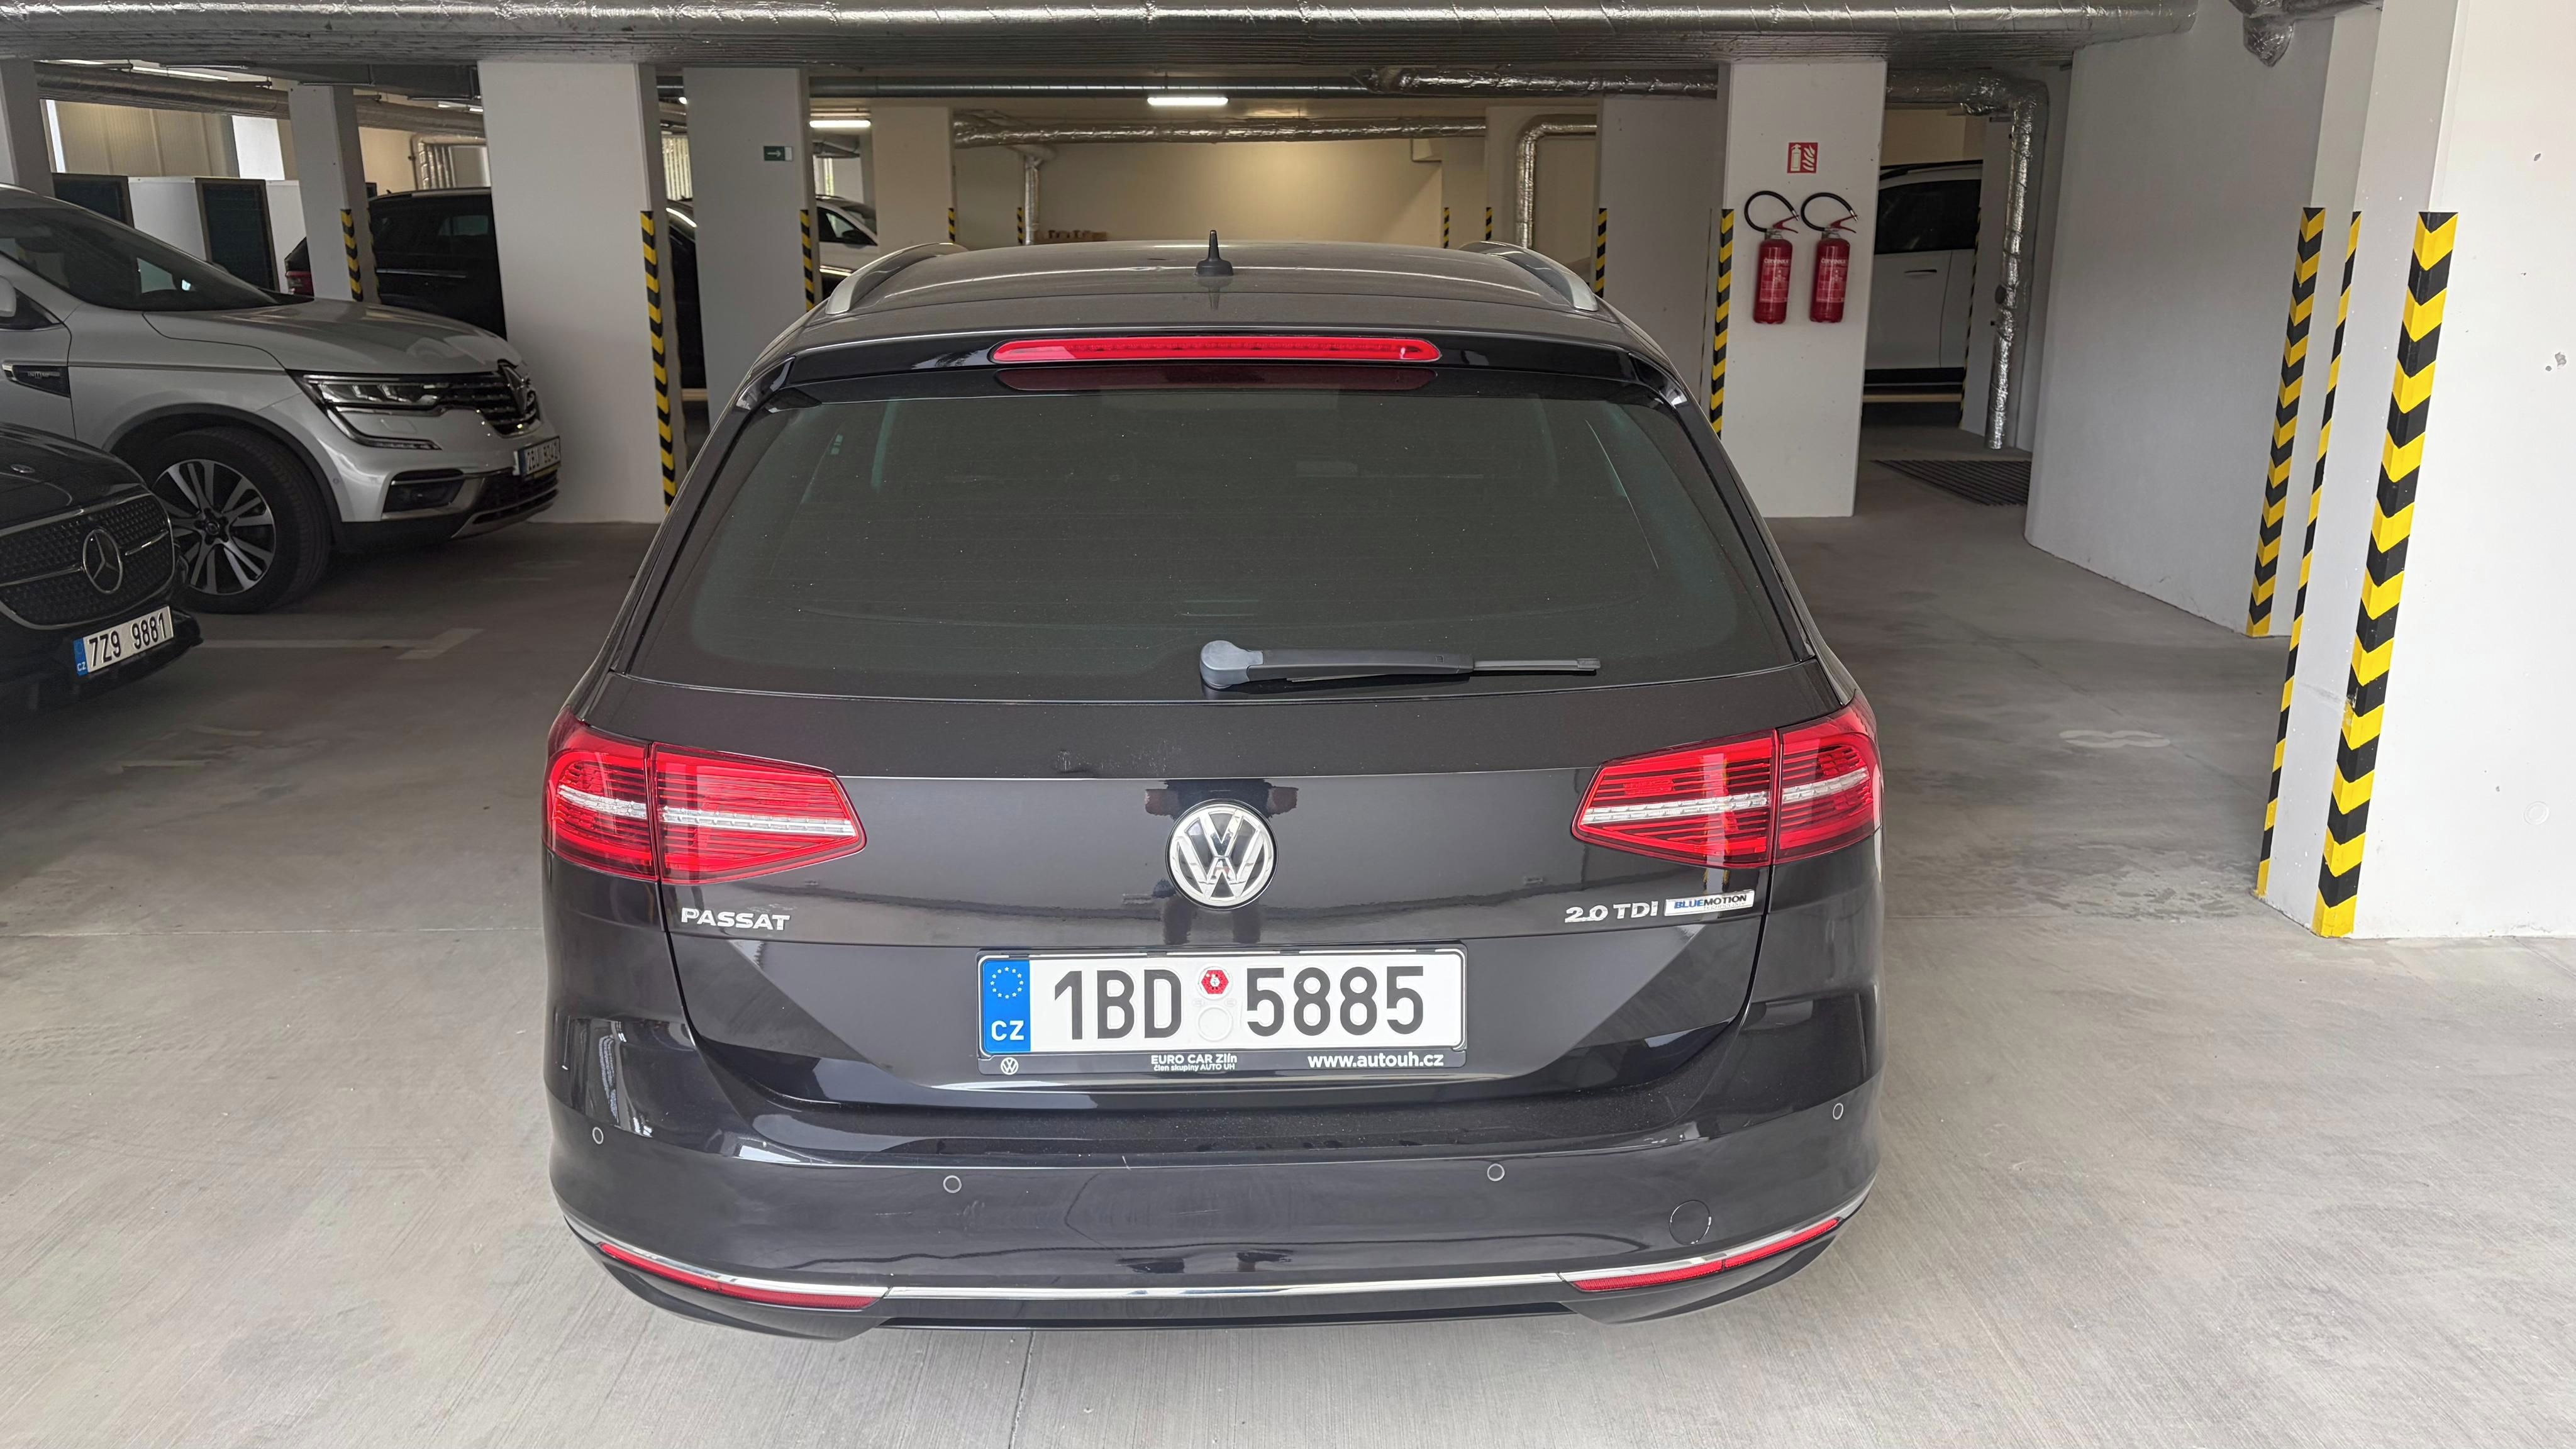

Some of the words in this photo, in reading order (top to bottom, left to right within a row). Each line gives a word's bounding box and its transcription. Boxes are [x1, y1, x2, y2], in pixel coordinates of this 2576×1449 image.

[89, 630, 121, 667] 7Z9
[131, 612, 167, 650] 9881
[77, 661, 87, 672] CZ
[1674, 894, 1747, 909] BLUEMOTION
[680, 907, 791, 931] PASSAT
[1564, 904, 1609, 923] 2.0
[1613, 901, 1659, 919] TDI
[1054, 969, 1182, 1040] 1BD
[1246, 966, 1424, 1037] 5885
[991, 1020, 1024, 1041] CZ
[1151, 1054, 1185, 1064] EURO
[1187, 1053, 1213, 1063] CAR
[1216, 1053, 1238, 1063] Zlín
[1171, 1063, 1199, 1072] skupiny
[1307, 1051, 1445, 1068] www.autouh.cz
